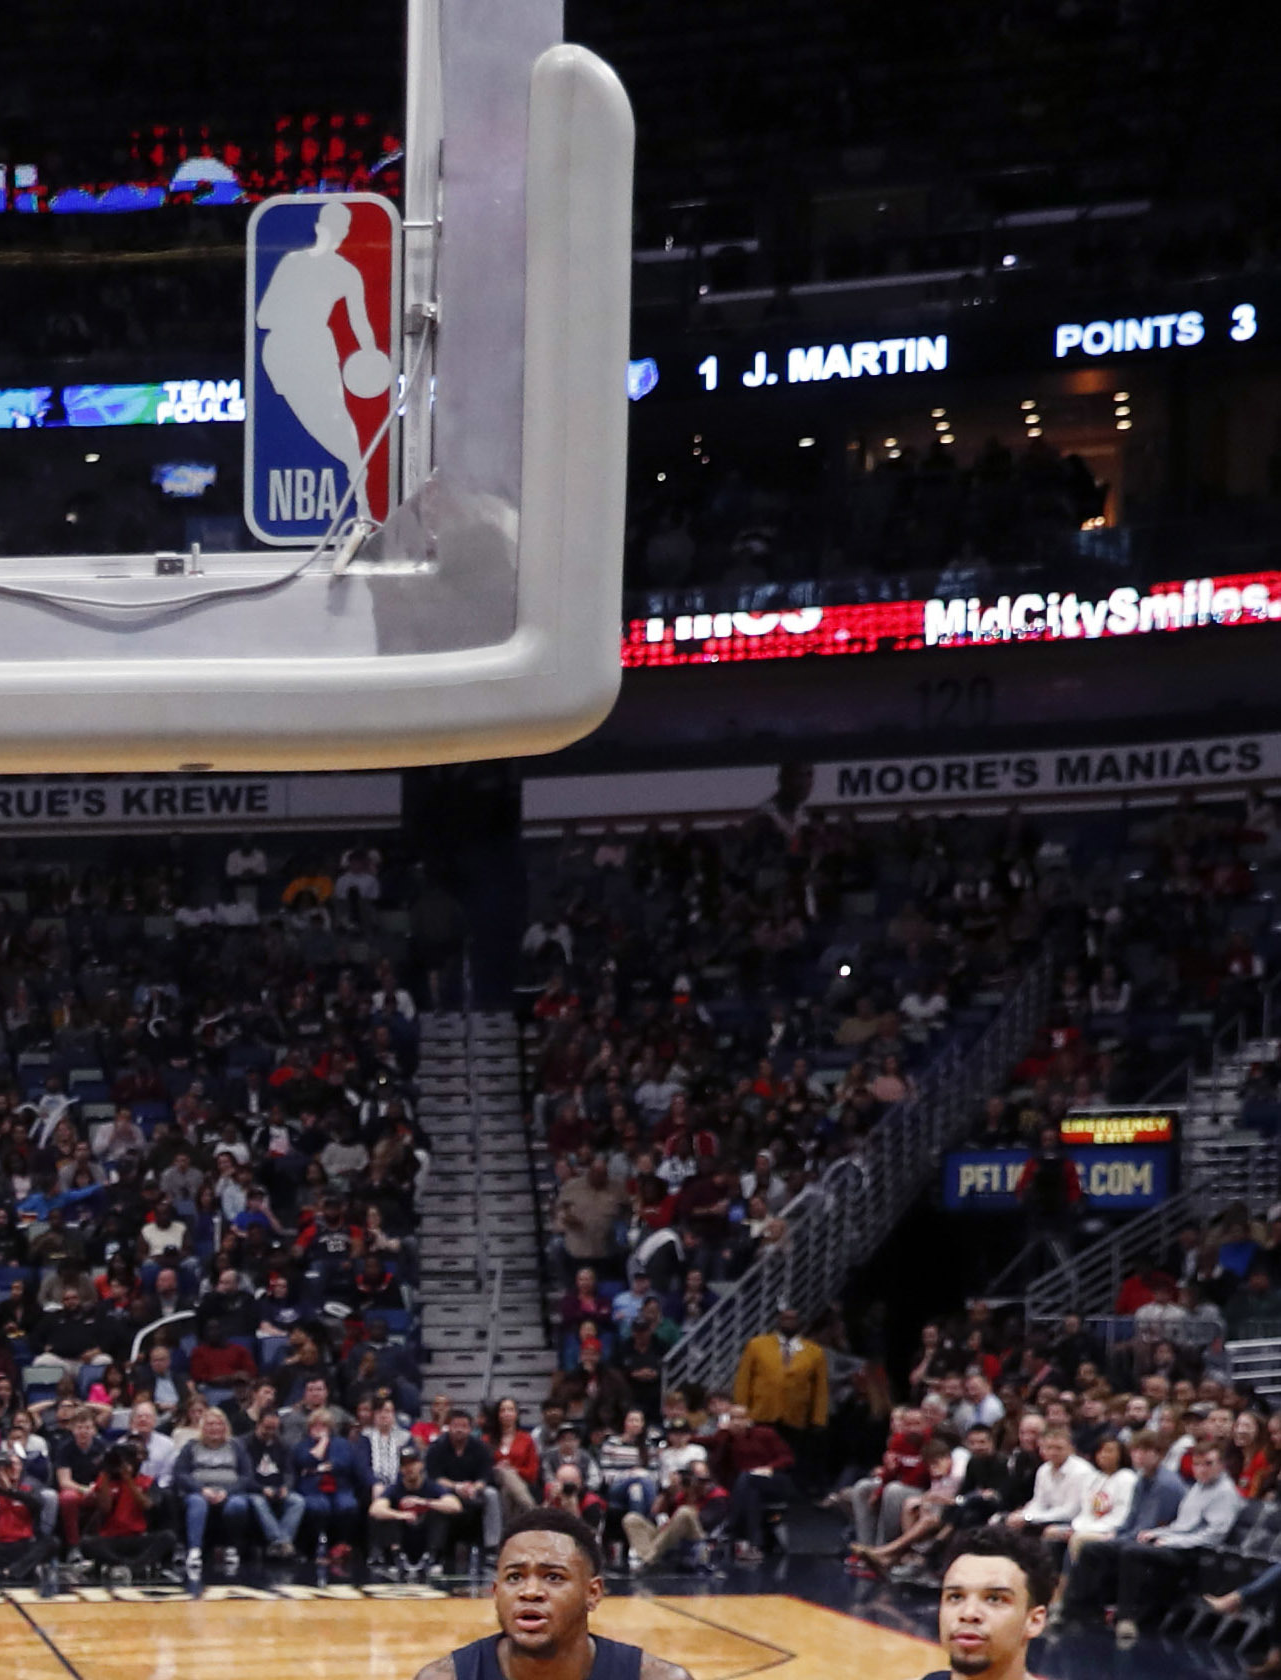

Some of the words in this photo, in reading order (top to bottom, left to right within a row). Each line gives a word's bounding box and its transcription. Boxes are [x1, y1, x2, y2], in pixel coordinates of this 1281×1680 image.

[1055, 311, 1205, 358] POINTS
[1230, 303, 1257, 340] 3
[162, 379, 241, 402] TEAM
[698, 356, 718, 391] 1
[742, 352, 779, 389] J.
[788, 335, 948, 385] MARTIN
[156, 399, 247, 425] FOULS
[267, 467, 339, 522] NBA
[837, 757, 1039, 798] MOORE'S
[1054, 741, 1263, 787] MANIACS
[121, 778, 271, 817] KREWE
